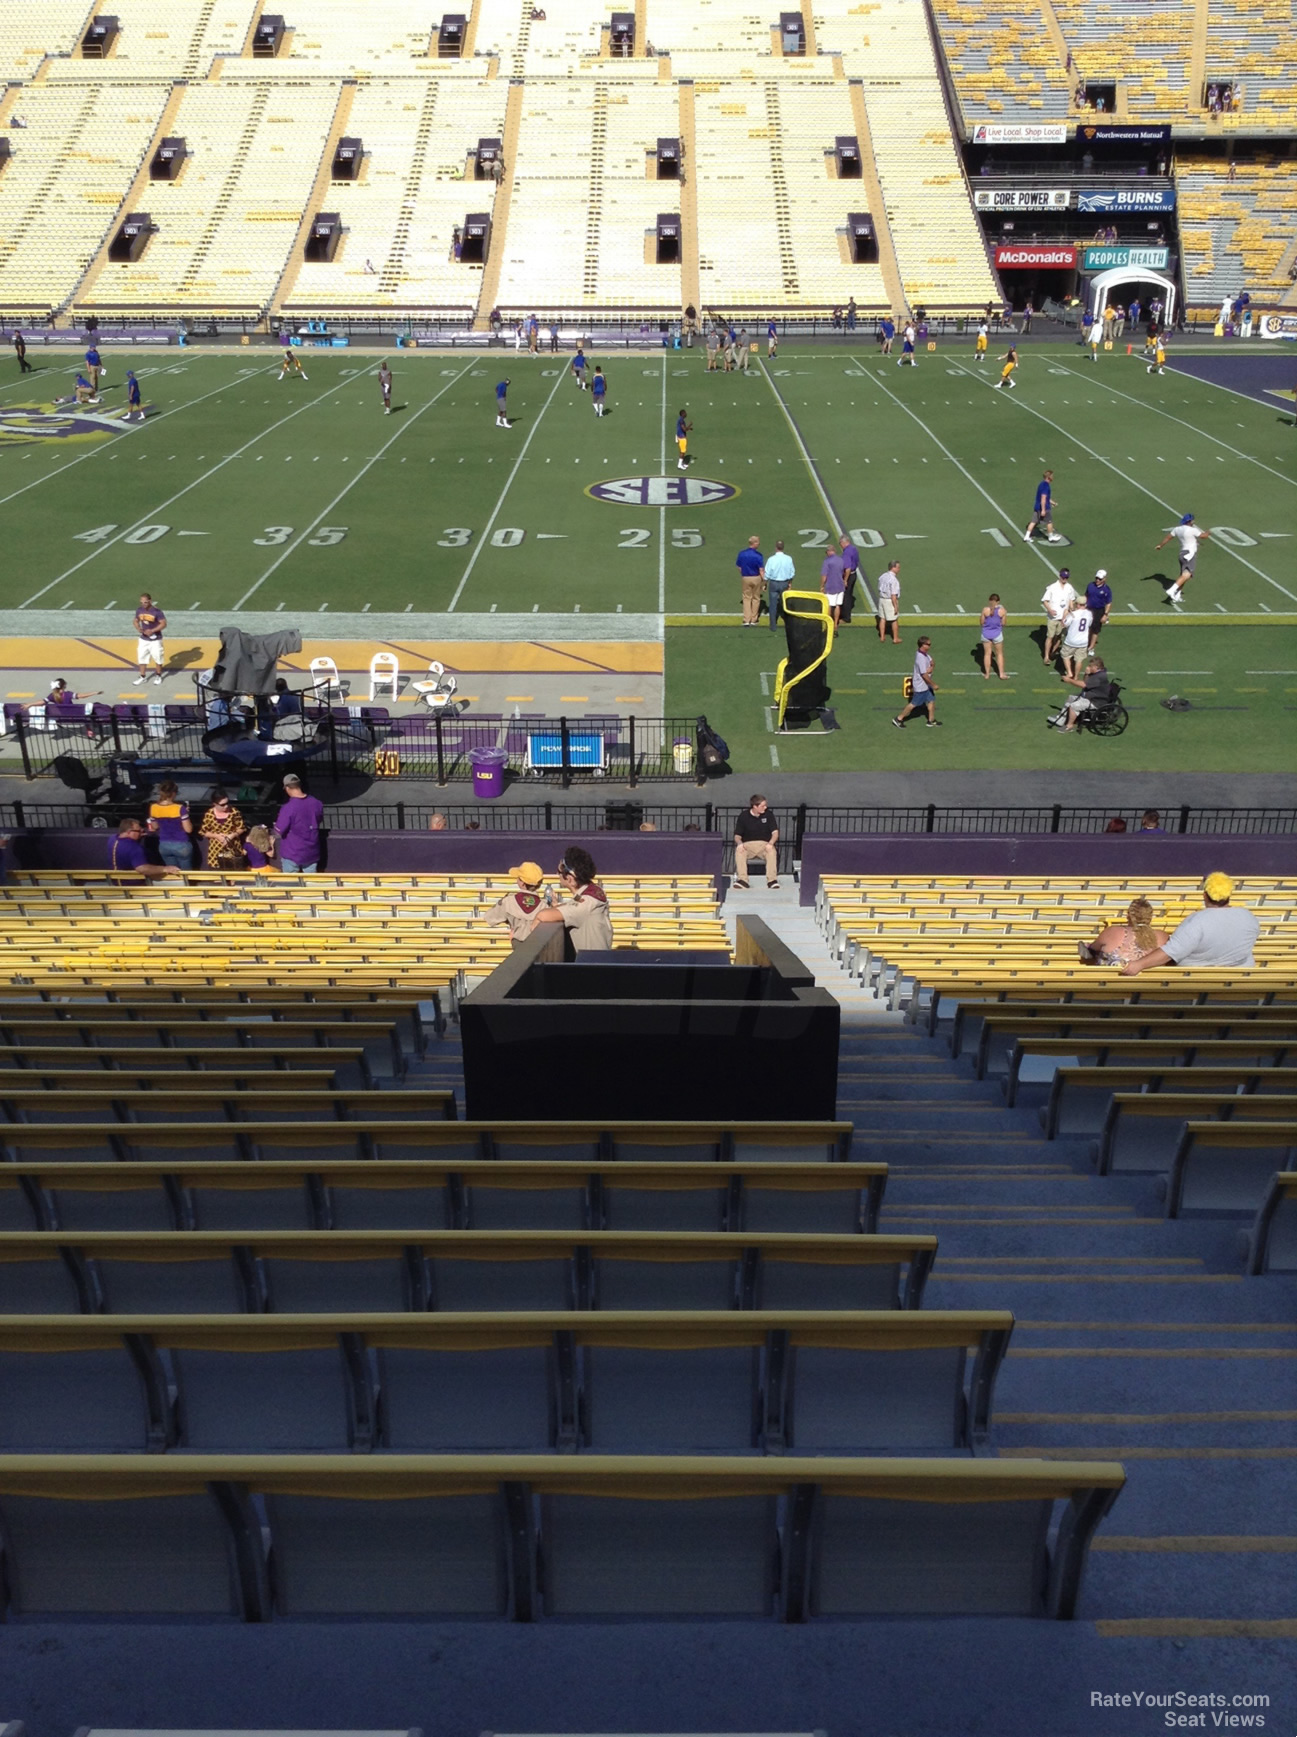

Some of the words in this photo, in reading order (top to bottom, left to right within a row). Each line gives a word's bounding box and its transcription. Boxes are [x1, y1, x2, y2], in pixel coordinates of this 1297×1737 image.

[988, 128, 1002, 136] Live
[1025, 128, 1042, 137] Shop
[994, 192, 1016, 205] CORE
[1018, 192, 1050, 205] POWER
[1117, 192, 1163, 204] BURNS
[999, 251, 1073, 263] McDonald's
[1089, 252, 1128, 265] PEOPLES
[1131, 253, 1164, 265] HEALTH
[600, 477, 726, 505] SEC
[1078, 617, 1088, 632] 8
[477, 771, 493, 780] LSU
